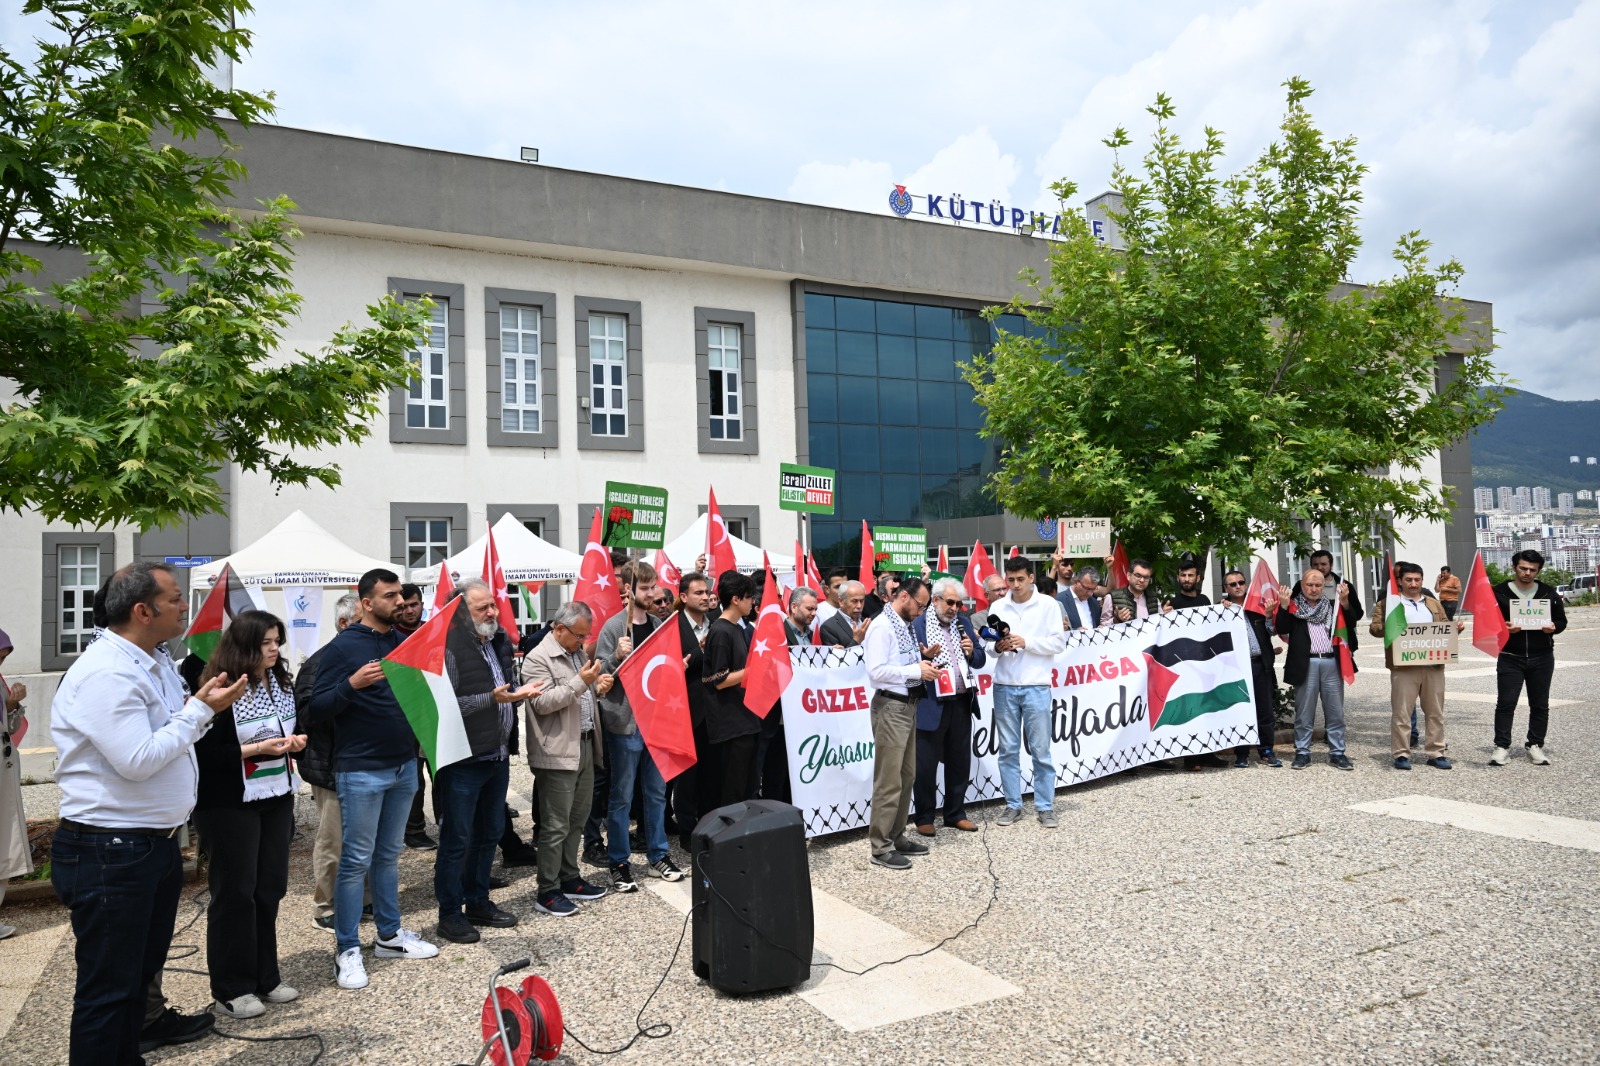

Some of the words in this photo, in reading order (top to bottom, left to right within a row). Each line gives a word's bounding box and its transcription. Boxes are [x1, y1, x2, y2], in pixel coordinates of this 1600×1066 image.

[927, 193, 1105, 241] KÜTÜPHAE
[806, 491, 832, 505] DEVLET
[632, 508, 664, 529] DİRENİŞ
[1068, 520, 1085, 529] LET
[1089, 520, 1106, 528] THE
[1067, 531, 1106, 542] CHILDREN
[1518, 608, 1545, 616] LOVE
[1431, 624, 1452, 635] THE
[1400, 638, 1449, 650] GENOCIDE
[801, 685, 870, 714] GAZZE
[1063, 655, 1141, 687] AYAĞA
